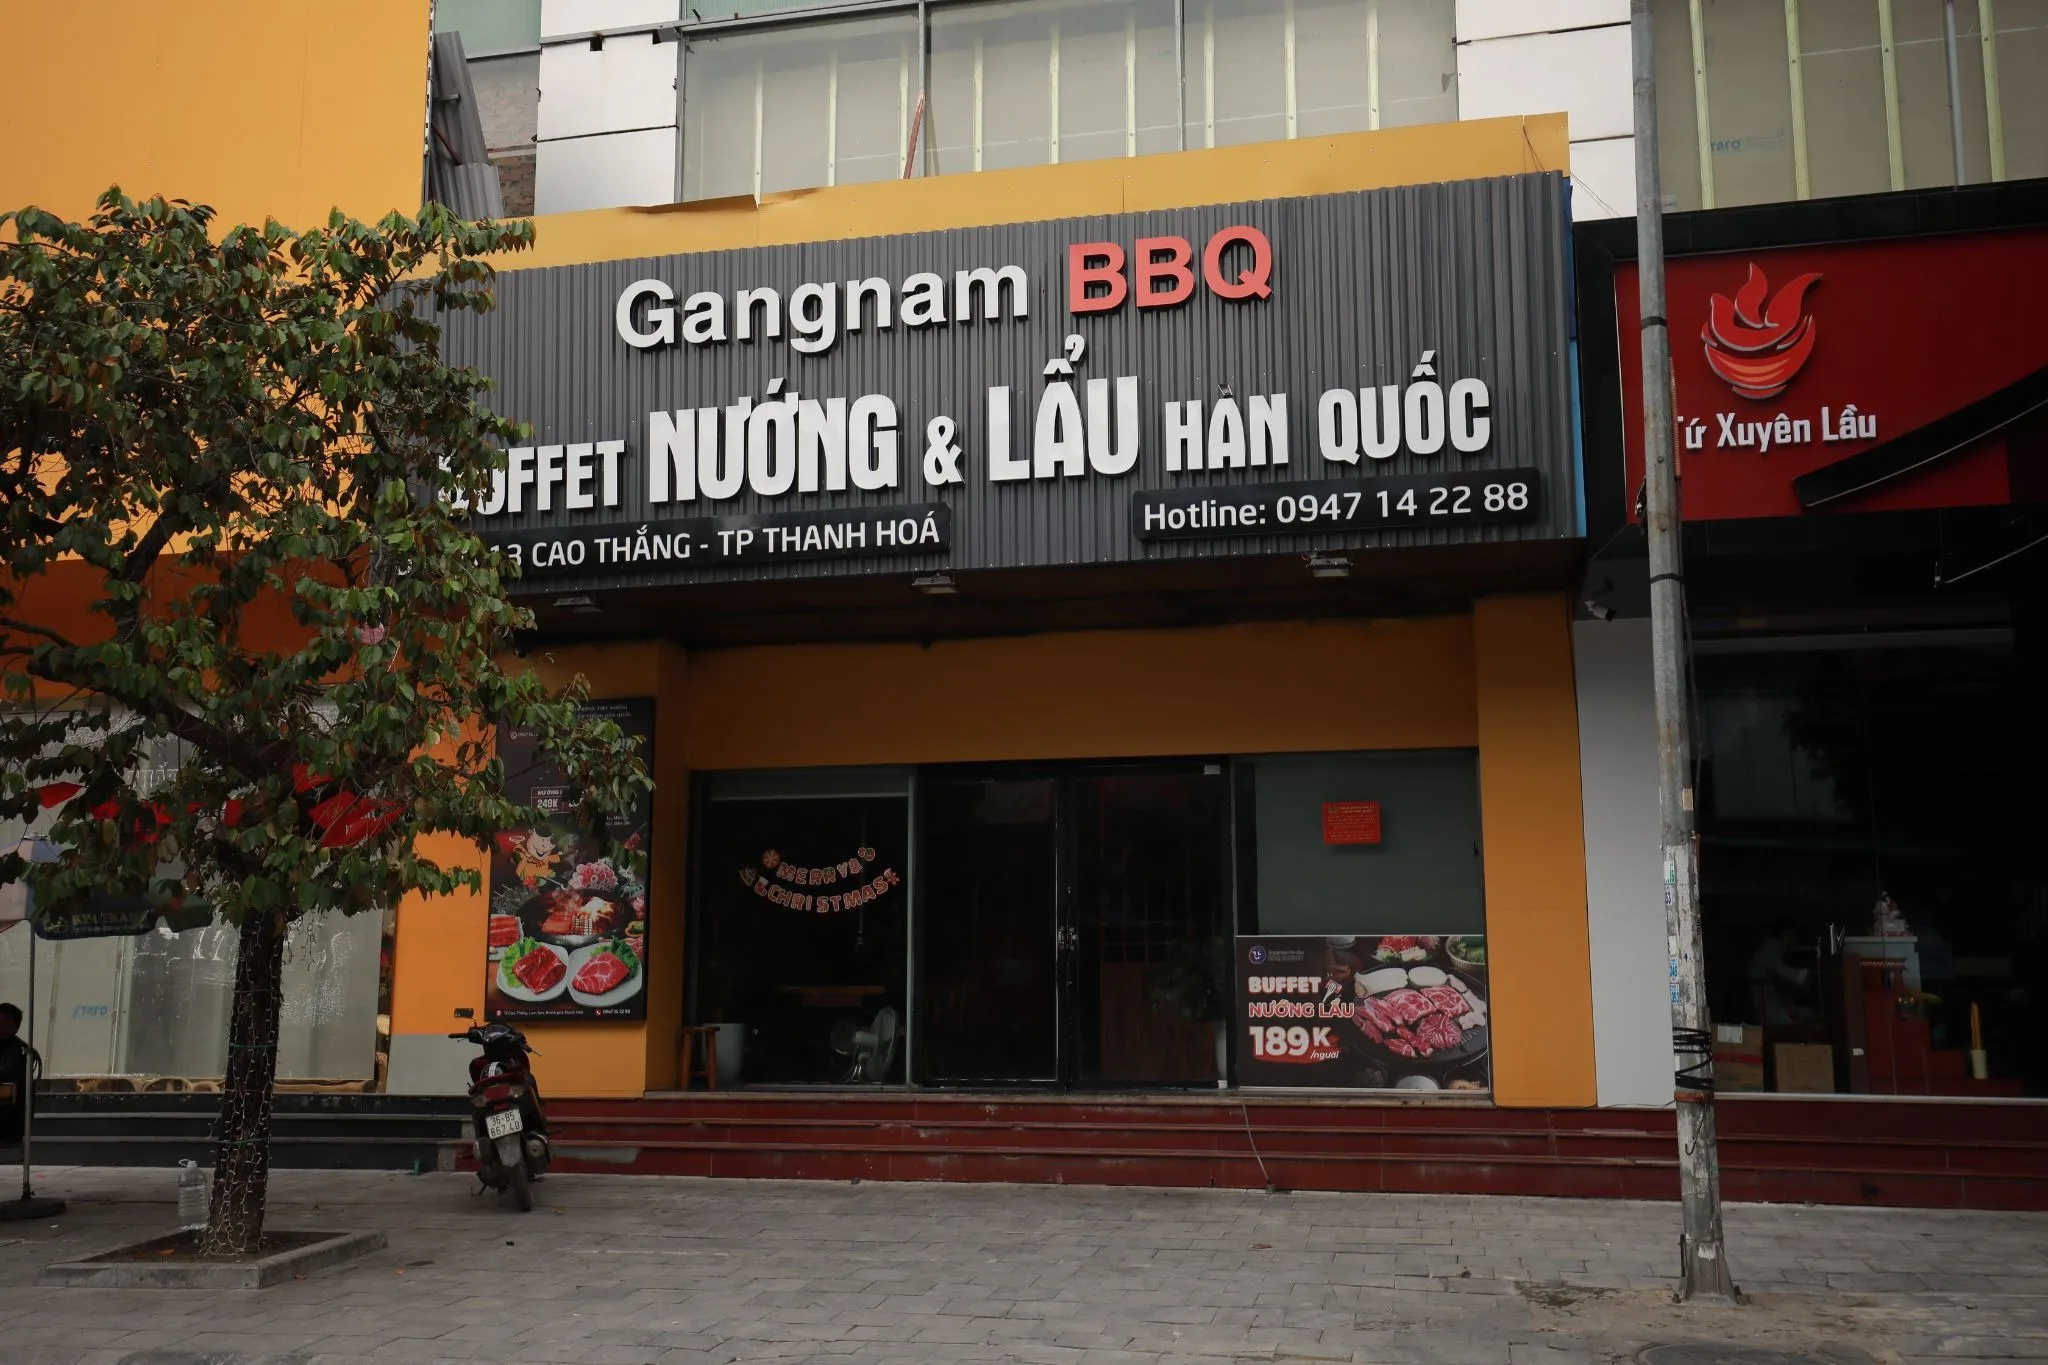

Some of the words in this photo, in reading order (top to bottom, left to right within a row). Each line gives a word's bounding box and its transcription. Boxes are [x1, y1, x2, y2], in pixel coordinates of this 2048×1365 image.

[616, 262, 1029, 353] Gangnam
[1069, 225, 1272, 313] BBQ
[650, 377, 899, 502] NƯỚNG
[923, 415, 963, 485] &
[989, 333, 1140, 481] LẨU
[1165, 383, 1289, 472] HÀN
[1318, 350, 1492, 466] QUỐC
[1716, 412, 1811, 453] Xuyên
[1821, 404, 1877, 441] Lầu
[1144, 500, 1266, 531] Hotline:
[1276, 492, 1362, 523] 0947
[1376, 488, 1418, 518] 14
[1429, 485, 1472, 515] 22
[1483, 482, 1529, 512] 88
[532, 540, 586, 567] CAO
[594, 525, 691, 563] THẮNG
[718, 529, 755, 556] TP
[762, 521, 866, 553] THANH
[876, 510, 940, 547] HOÁ
[767, 875, 889, 913] CHRISTMAS
[776, 861, 849, 886] MERRY
[1248, 976, 1322, 993] BUFFET
[1248, 999, 1315, 1018] NƯỚNG
